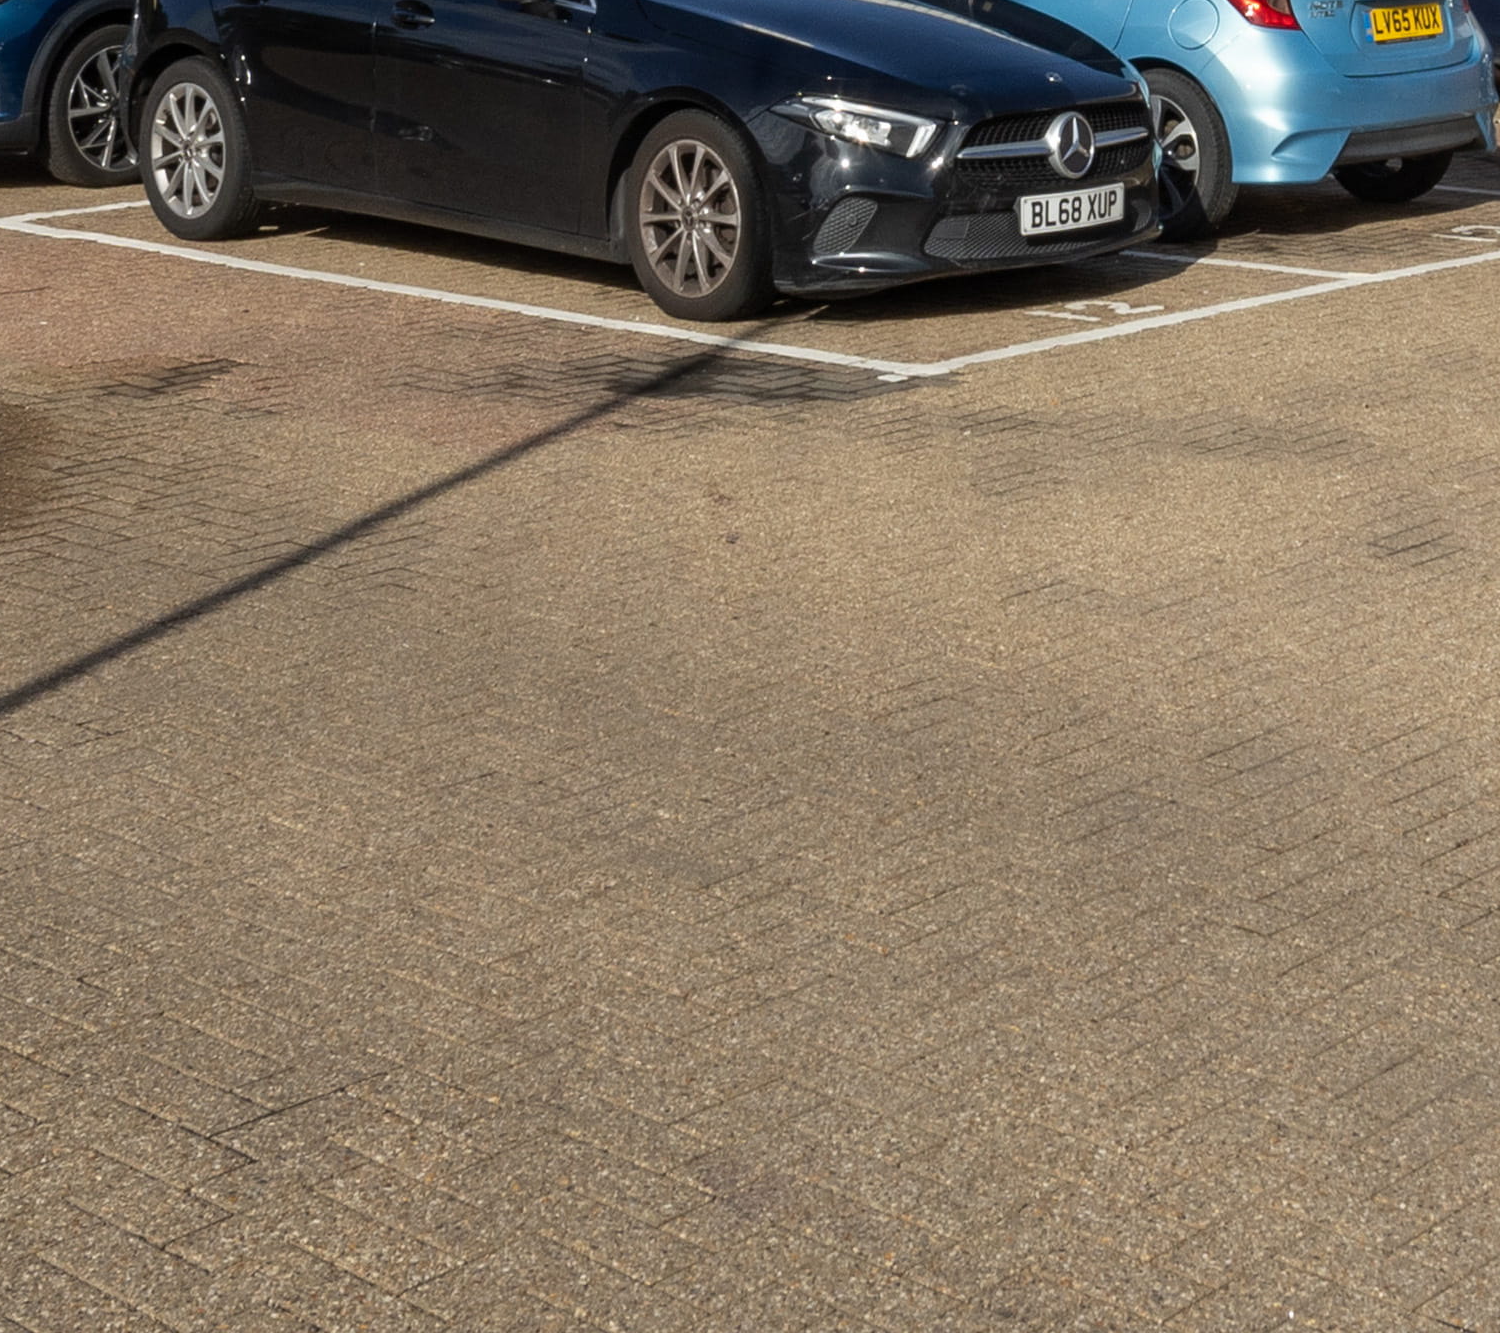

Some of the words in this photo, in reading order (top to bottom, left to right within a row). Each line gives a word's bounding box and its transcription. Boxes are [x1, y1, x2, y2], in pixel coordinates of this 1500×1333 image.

[1372, 9, 1411, 35] LV65
[1414, 5, 1440, 30] KUX
[1031, 196, 1082, 229] BL68
[1087, 190, 1117, 221] XUP
